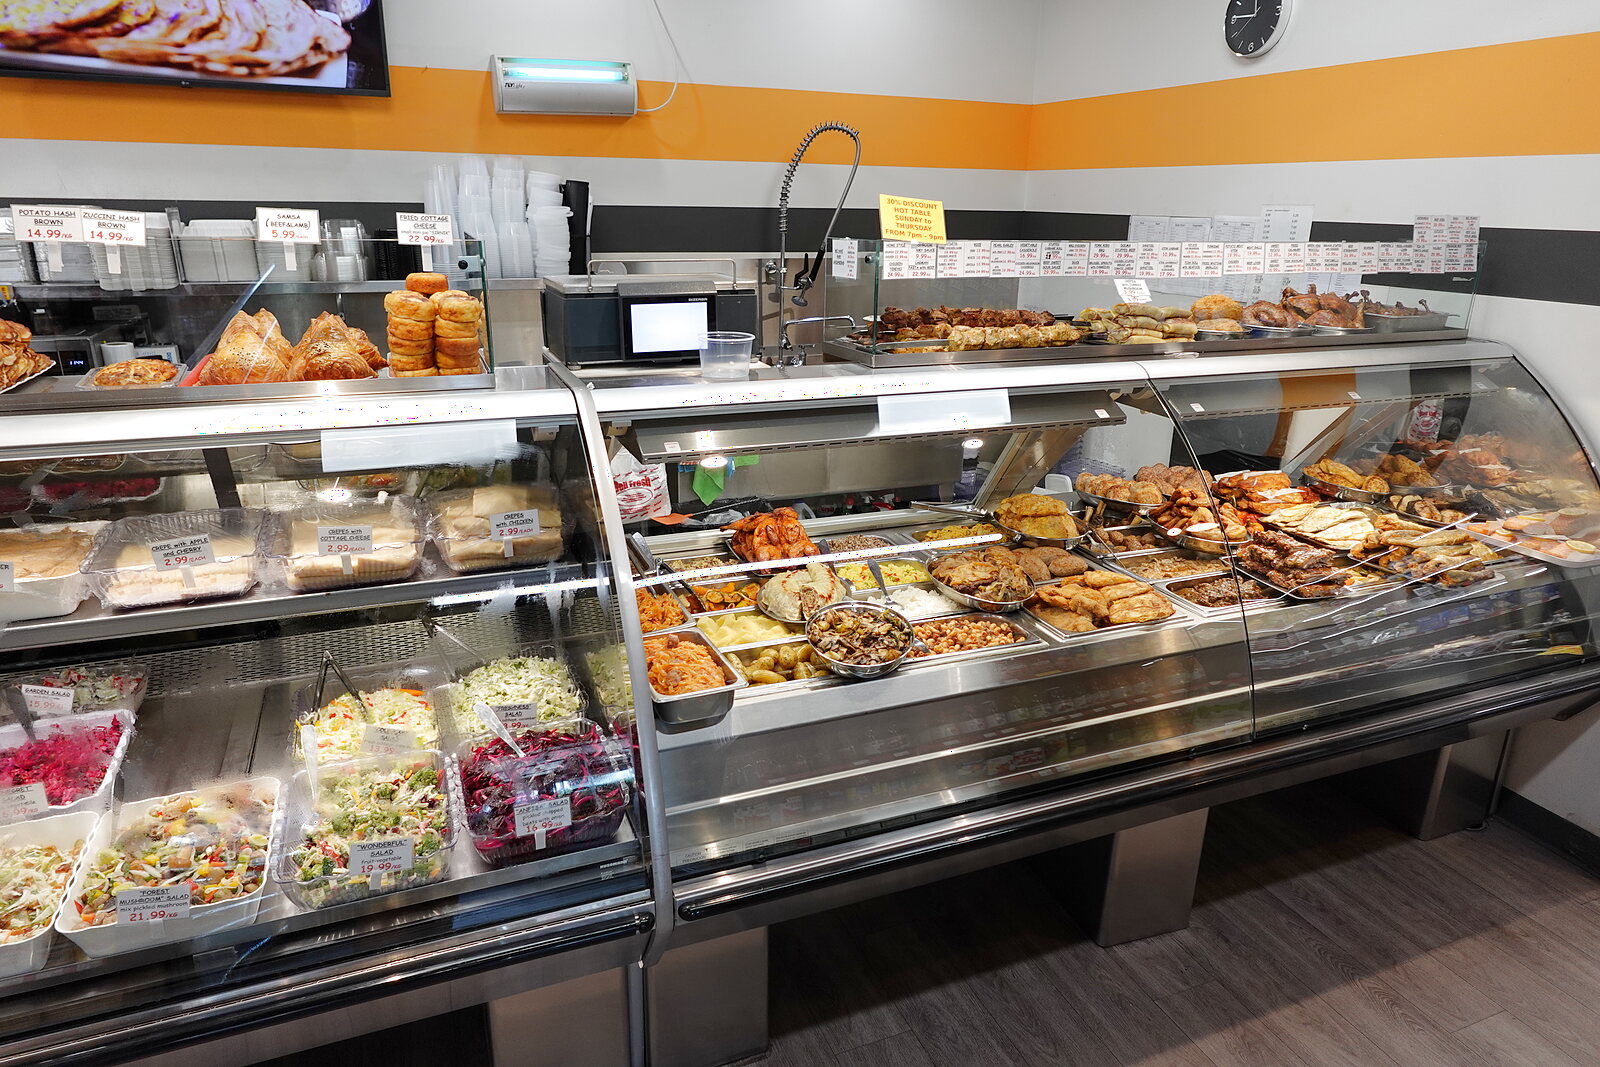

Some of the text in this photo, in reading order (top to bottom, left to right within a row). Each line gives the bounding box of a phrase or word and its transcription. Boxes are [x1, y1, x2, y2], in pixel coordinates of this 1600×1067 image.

[1248, 42, 1254, 52] 6
[903, 200, 938, 210] DISCOUNT
[18, 208, 52, 217] POTATO
[82, 211, 140, 222] ZUCCINI HASH
[911, 208, 931, 217] TABLE
[33, 218, 64, 226] BROWN
[895, 214, 923, 224] SUNDAY
[97, 221, 126, 229] BROWN
[896, 222, 932, 232] THURSDAY
[26, 228, 73, 239] 14.99/KG
[89, 230, 134, 242] 14.99/KG
[885, 228, 906, 237] FROM
[908, 231, 923, 239] 7pm
[928, 233, 944, 241] 9pm
[629, 476, 652, 488] Fresh
[503, 512, 524, 520] CREPES
[508, 518, 534, 526] CHICKEN
[499, 527, 534, 537] 2.99/EACH
[151, 544, 171, 552] CREPE
[189, 537, 209, 546] APPLE
[327, 544, 366, 553] 2.99/EACH
[176, 546, 202, 555] CHERRY
[163, 555, 207, 567] 2.99/EACH
[548, 799, 569, 808] SALAD
[357, 839, 408, 850] "WONDERFUL"
[371, 849, 394, 857] SALAD
[140, 888, 170, 896] "FOREST
[166, 893, 189, 901] SALAD
[133, 904, 156, 912] pickled
[129, 910, 178, 922] 21.99/KG
